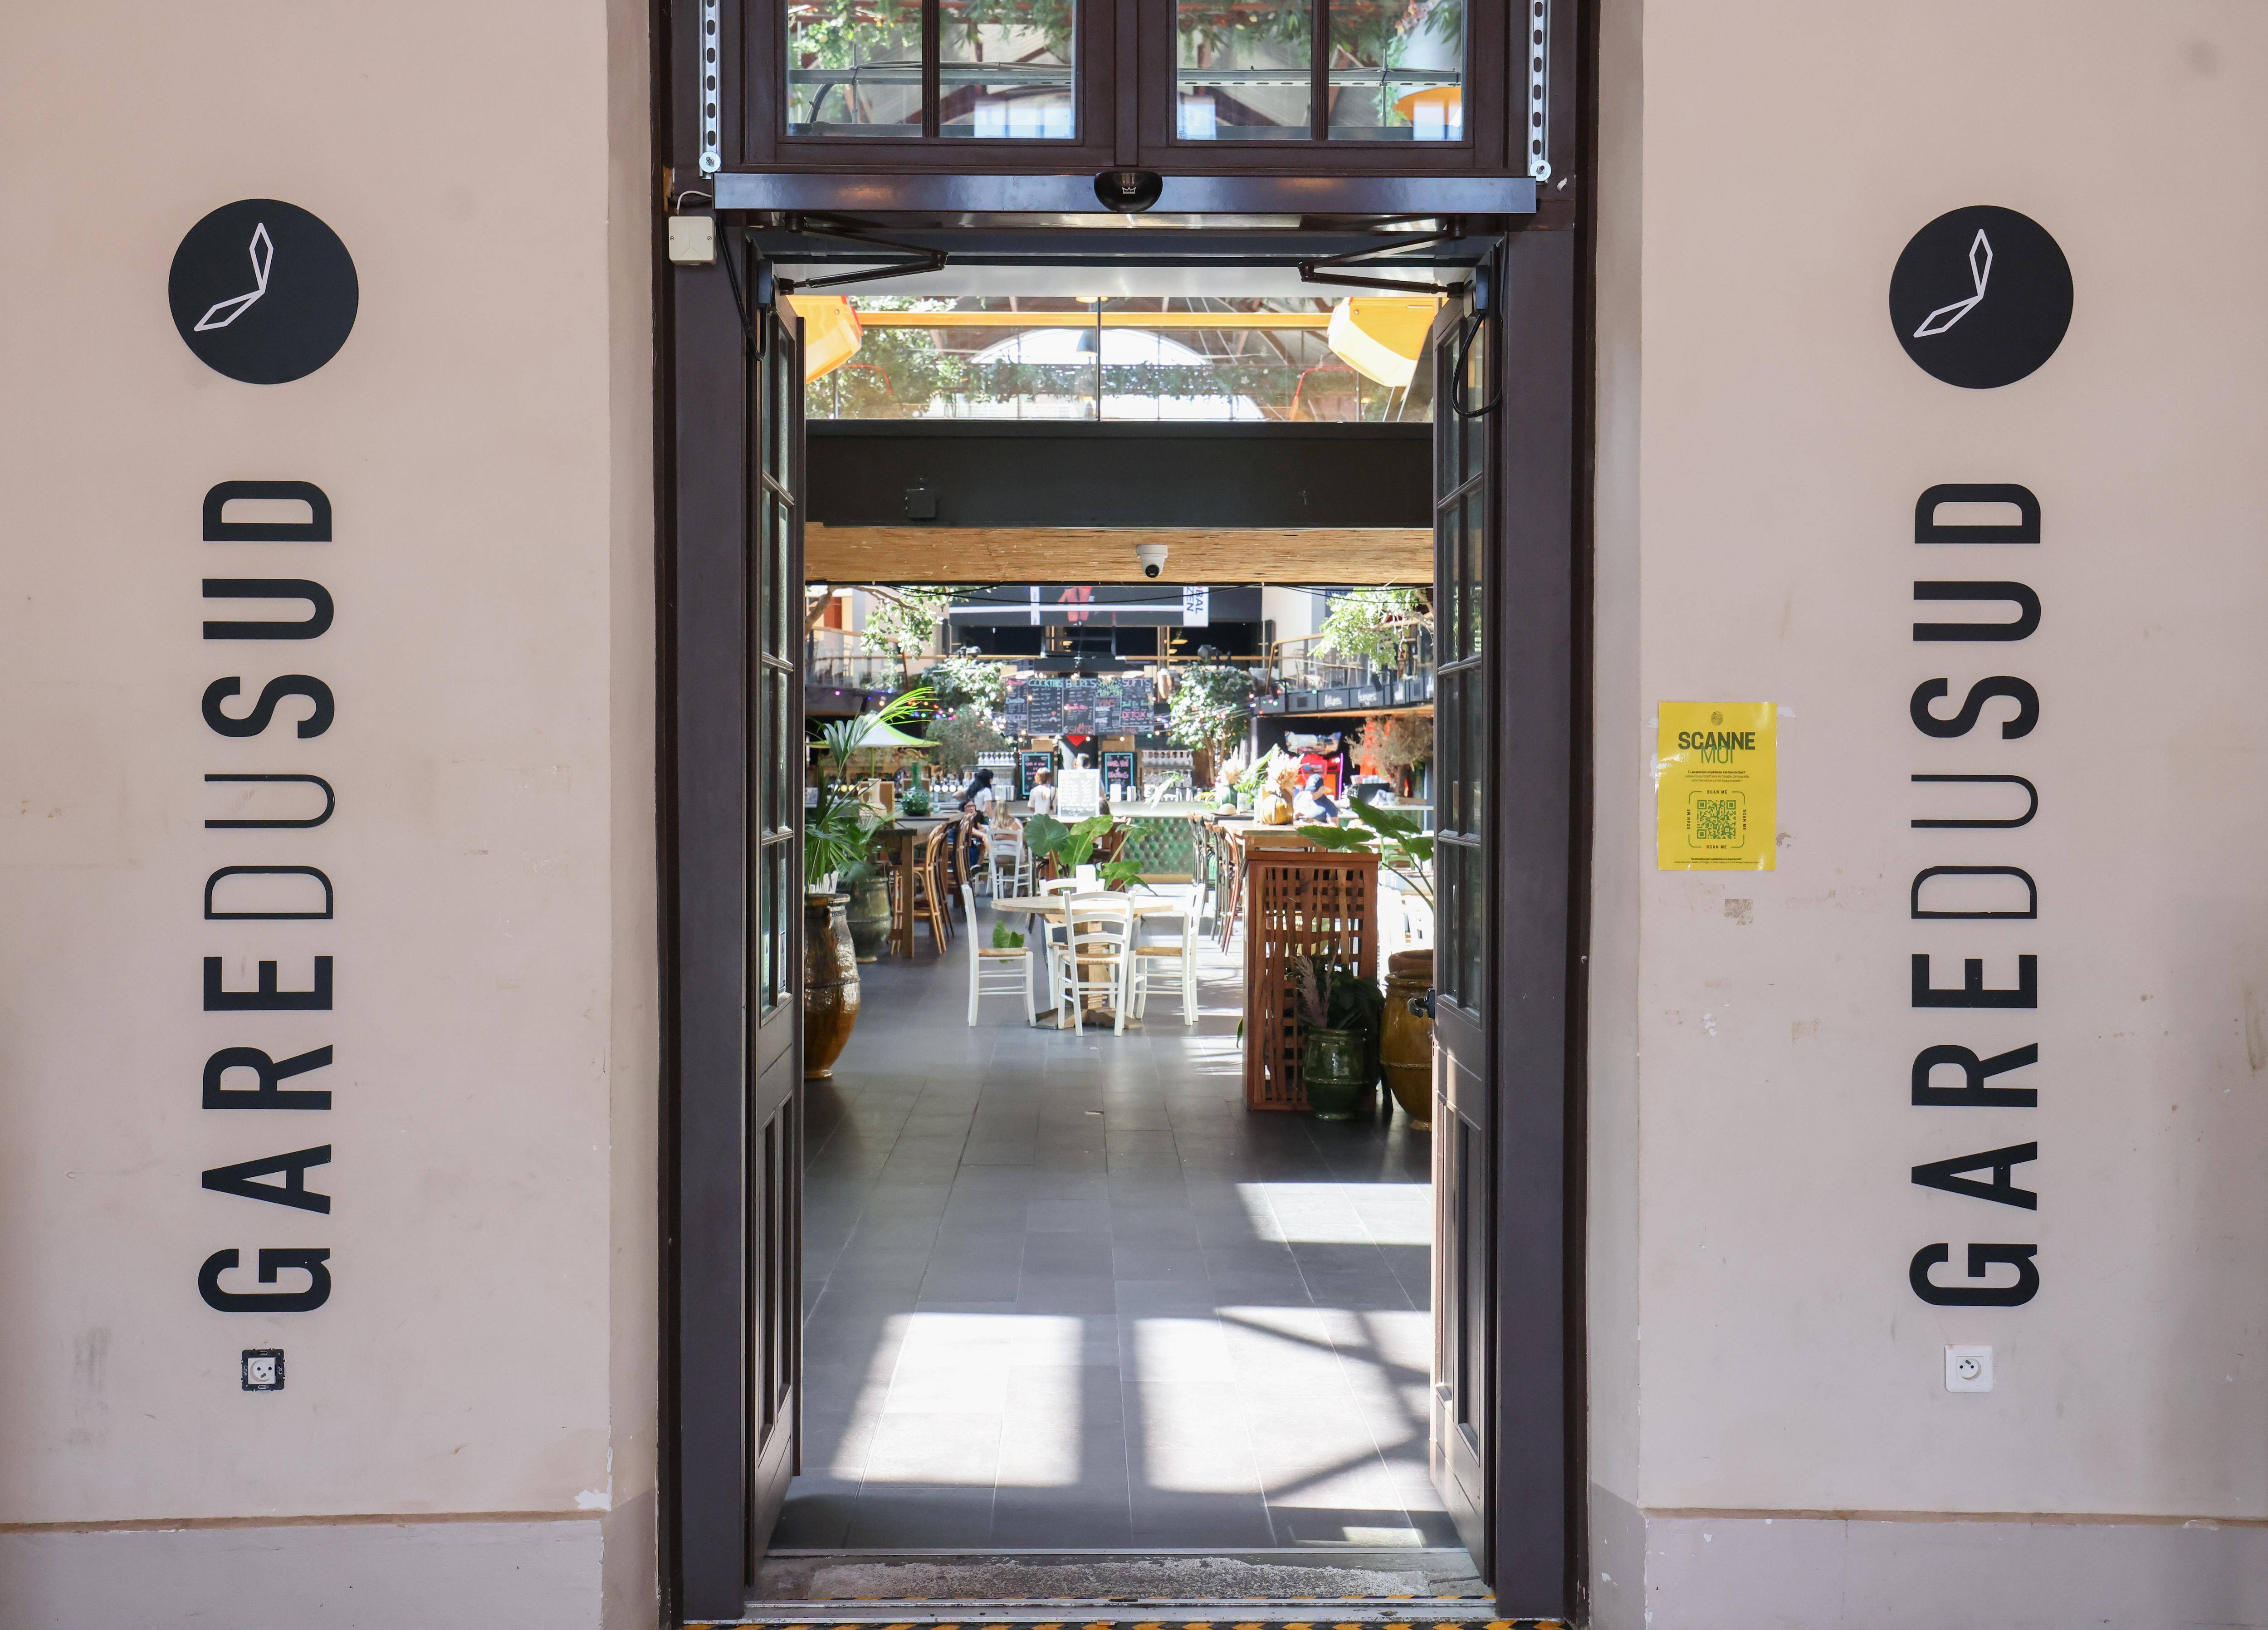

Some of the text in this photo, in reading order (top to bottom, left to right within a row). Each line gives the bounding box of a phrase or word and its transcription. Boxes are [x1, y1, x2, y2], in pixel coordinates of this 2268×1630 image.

[1122, 678, 1151, 687] SOFTS
[1122, 711, 1146, 719] DETOX
[1678, 731, 1755, 750] SCANNE
[1701, 745, 1733, 764] MOI
